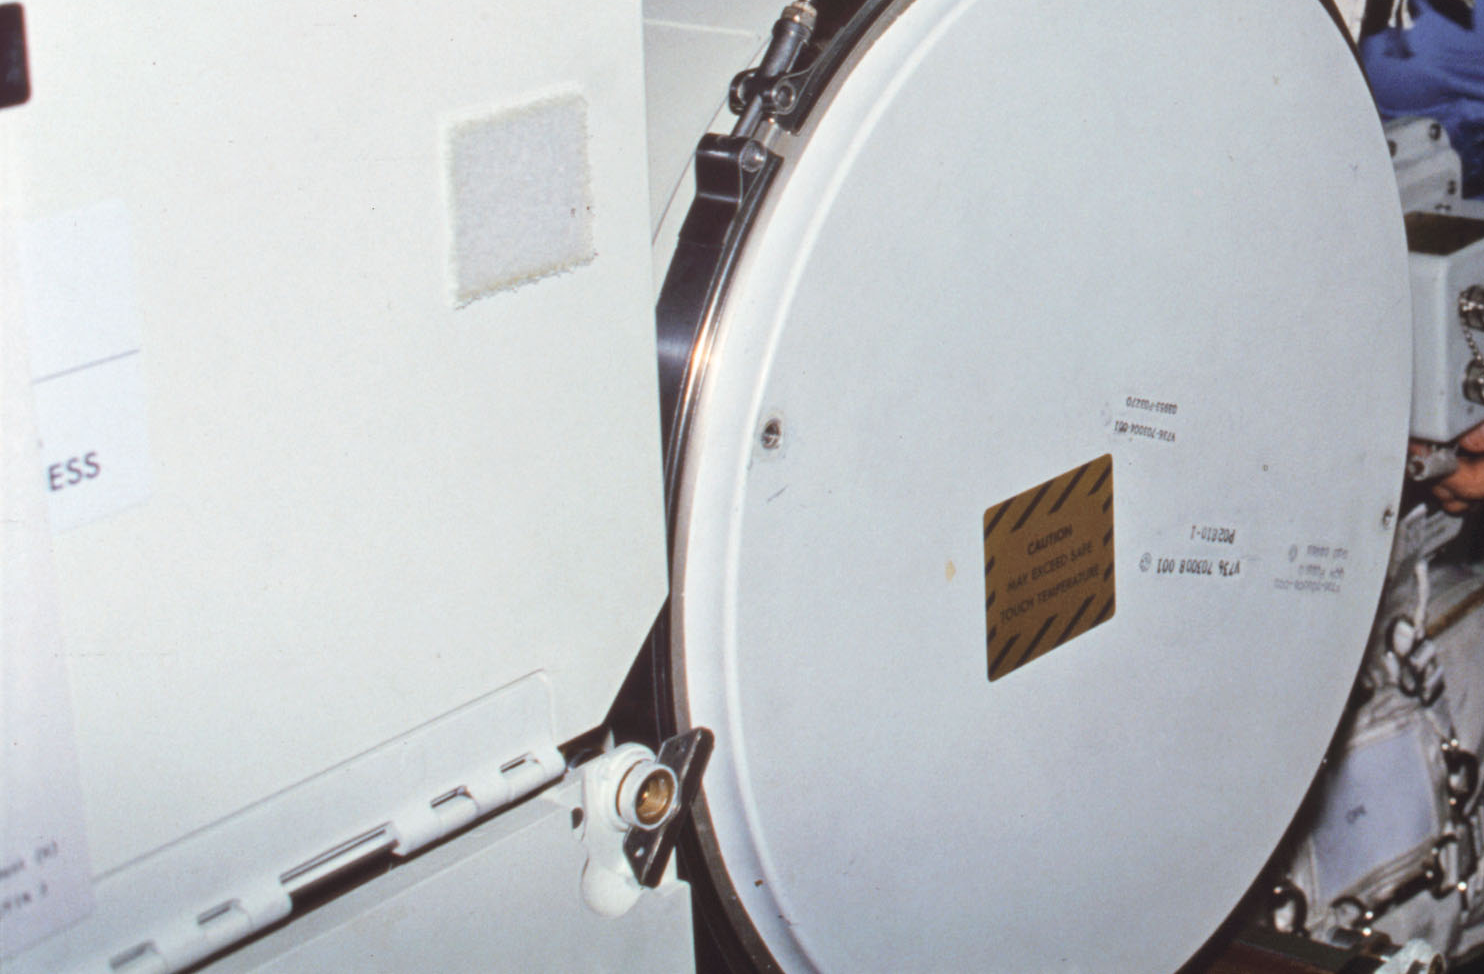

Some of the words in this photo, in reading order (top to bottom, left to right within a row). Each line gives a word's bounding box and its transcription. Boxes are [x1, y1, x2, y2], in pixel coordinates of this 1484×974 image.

[49, 451, 101, 492] ESS
[1027, 522, 1073, 556] CAUTION
[1007, 572, 1028, 592] MAY
[1032, 554, 1068, 581] EXCEED
[1071, 540, 1093, 563] SAFE
[1157, 558, 1175, 575] 001
[1000, 597, 1035, 624] TOUCH
[1038, 563, 1099, 603] TEMPERATURE
